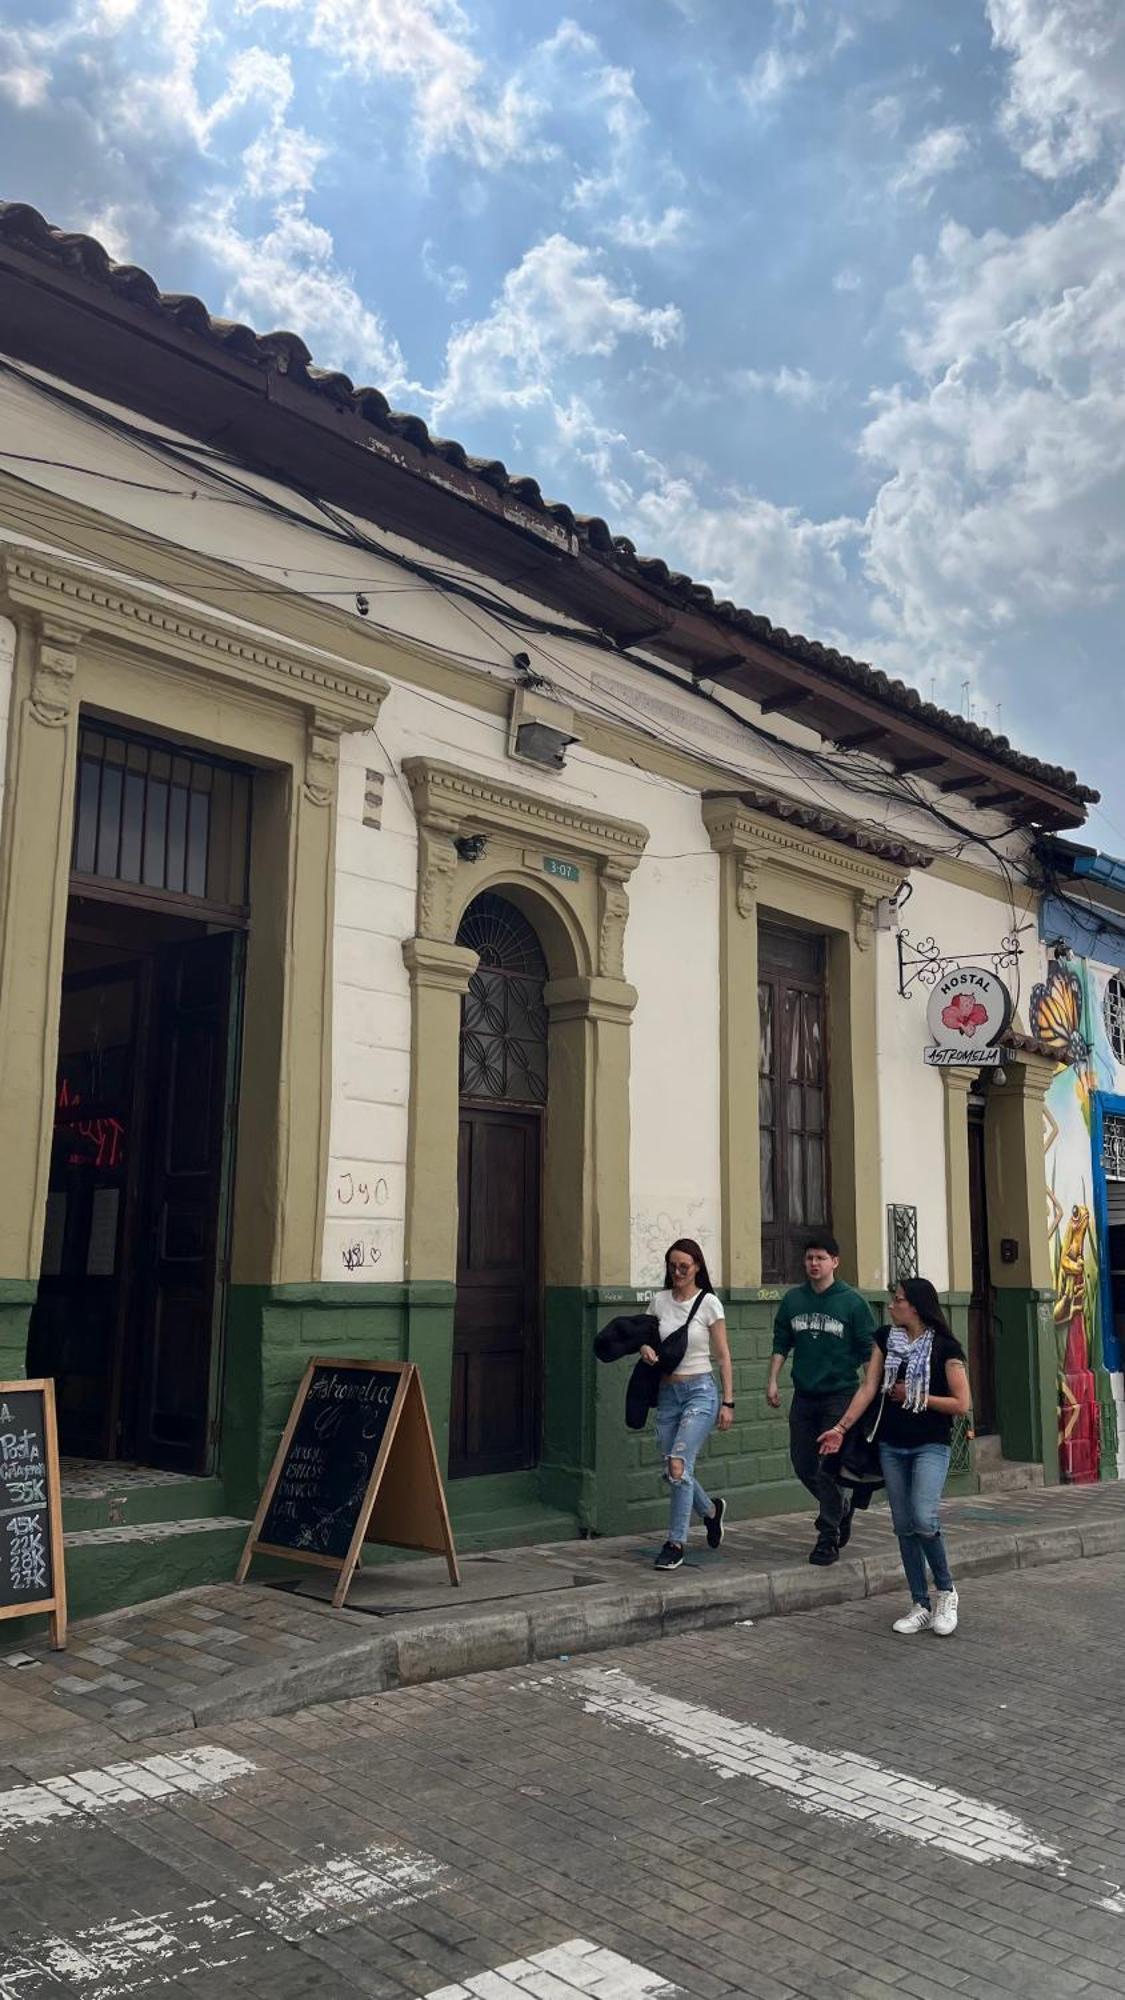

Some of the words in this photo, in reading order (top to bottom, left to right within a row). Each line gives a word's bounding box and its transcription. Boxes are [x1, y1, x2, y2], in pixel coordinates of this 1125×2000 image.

[941, 974, 992, 995] HOSTAL
[927, 1048, 999, 1064] ASTROMELIA
[6, 1478, 47, 1503] 35K
[6, 1514, 43, 1535] 45K
[10, 1533, 45, 1555] 22K
[10, 1549, 46, 1572] 28K
